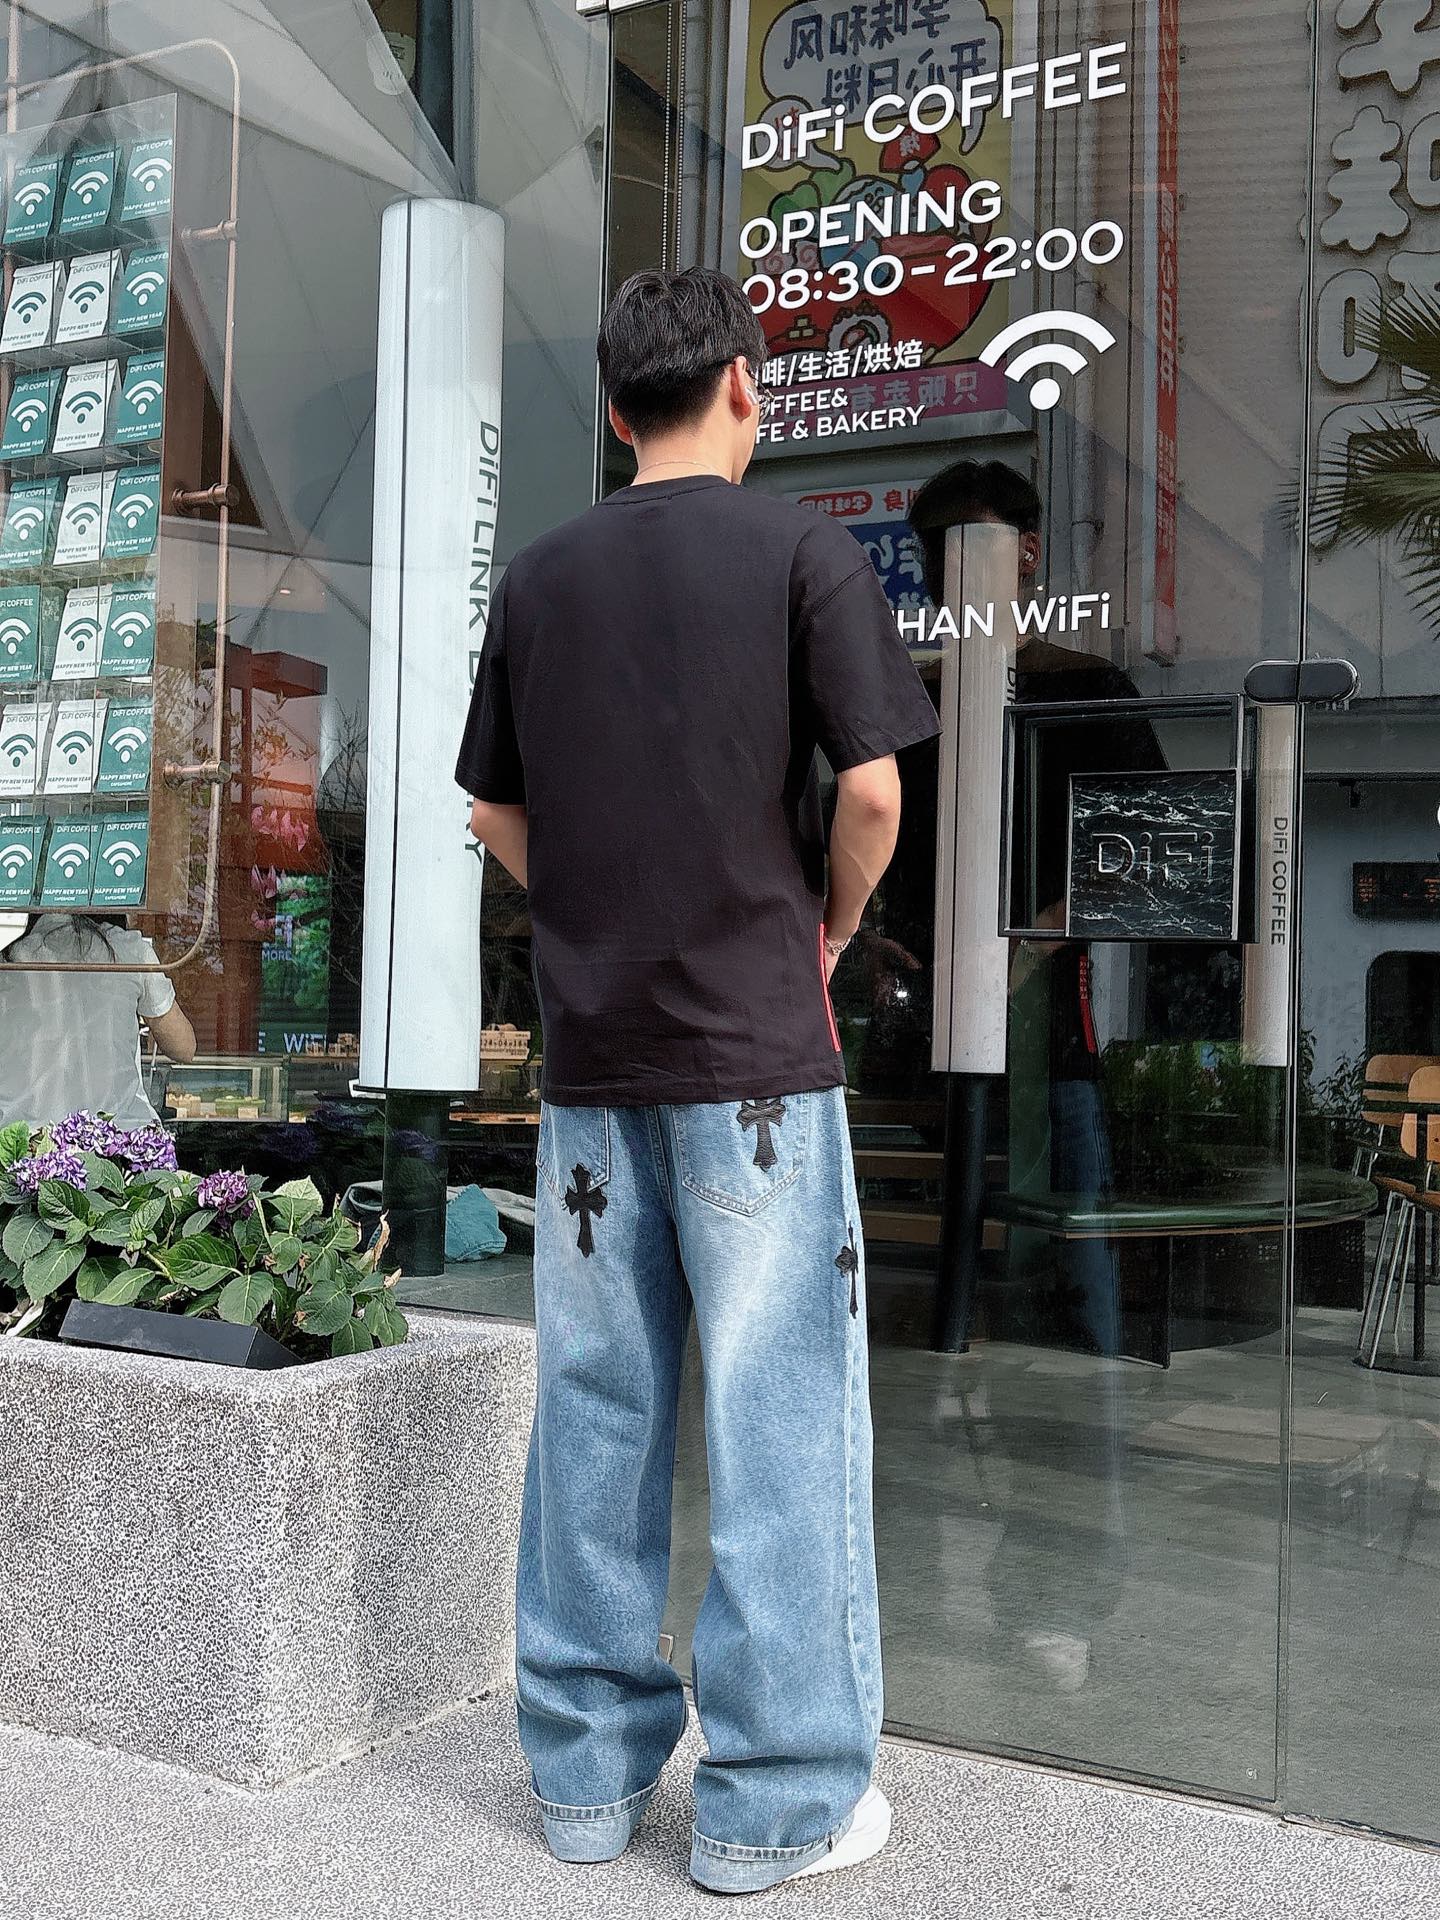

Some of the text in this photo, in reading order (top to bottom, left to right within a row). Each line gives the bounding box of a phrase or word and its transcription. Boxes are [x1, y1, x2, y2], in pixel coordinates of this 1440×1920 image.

[741, 103, 844, 171] DiFi
[863, 41, 1127, 144] COFFEE
[740, 179, 1002, 260] OPENING
[756, 339, 923, 387] 啡/生活/烘焙
[792, 419, 809, 440] &
[817, 404, 926, 437] BAKERY
[476, 420, 499, 507] DiFi
[468, 520, 494, 630] LINK
[891, 591, 1111, 642] HAN WiFi
[1090, 831, 1215, 888] DiFi
[1271, 816, 1288, 945] DiFi COFFEE
